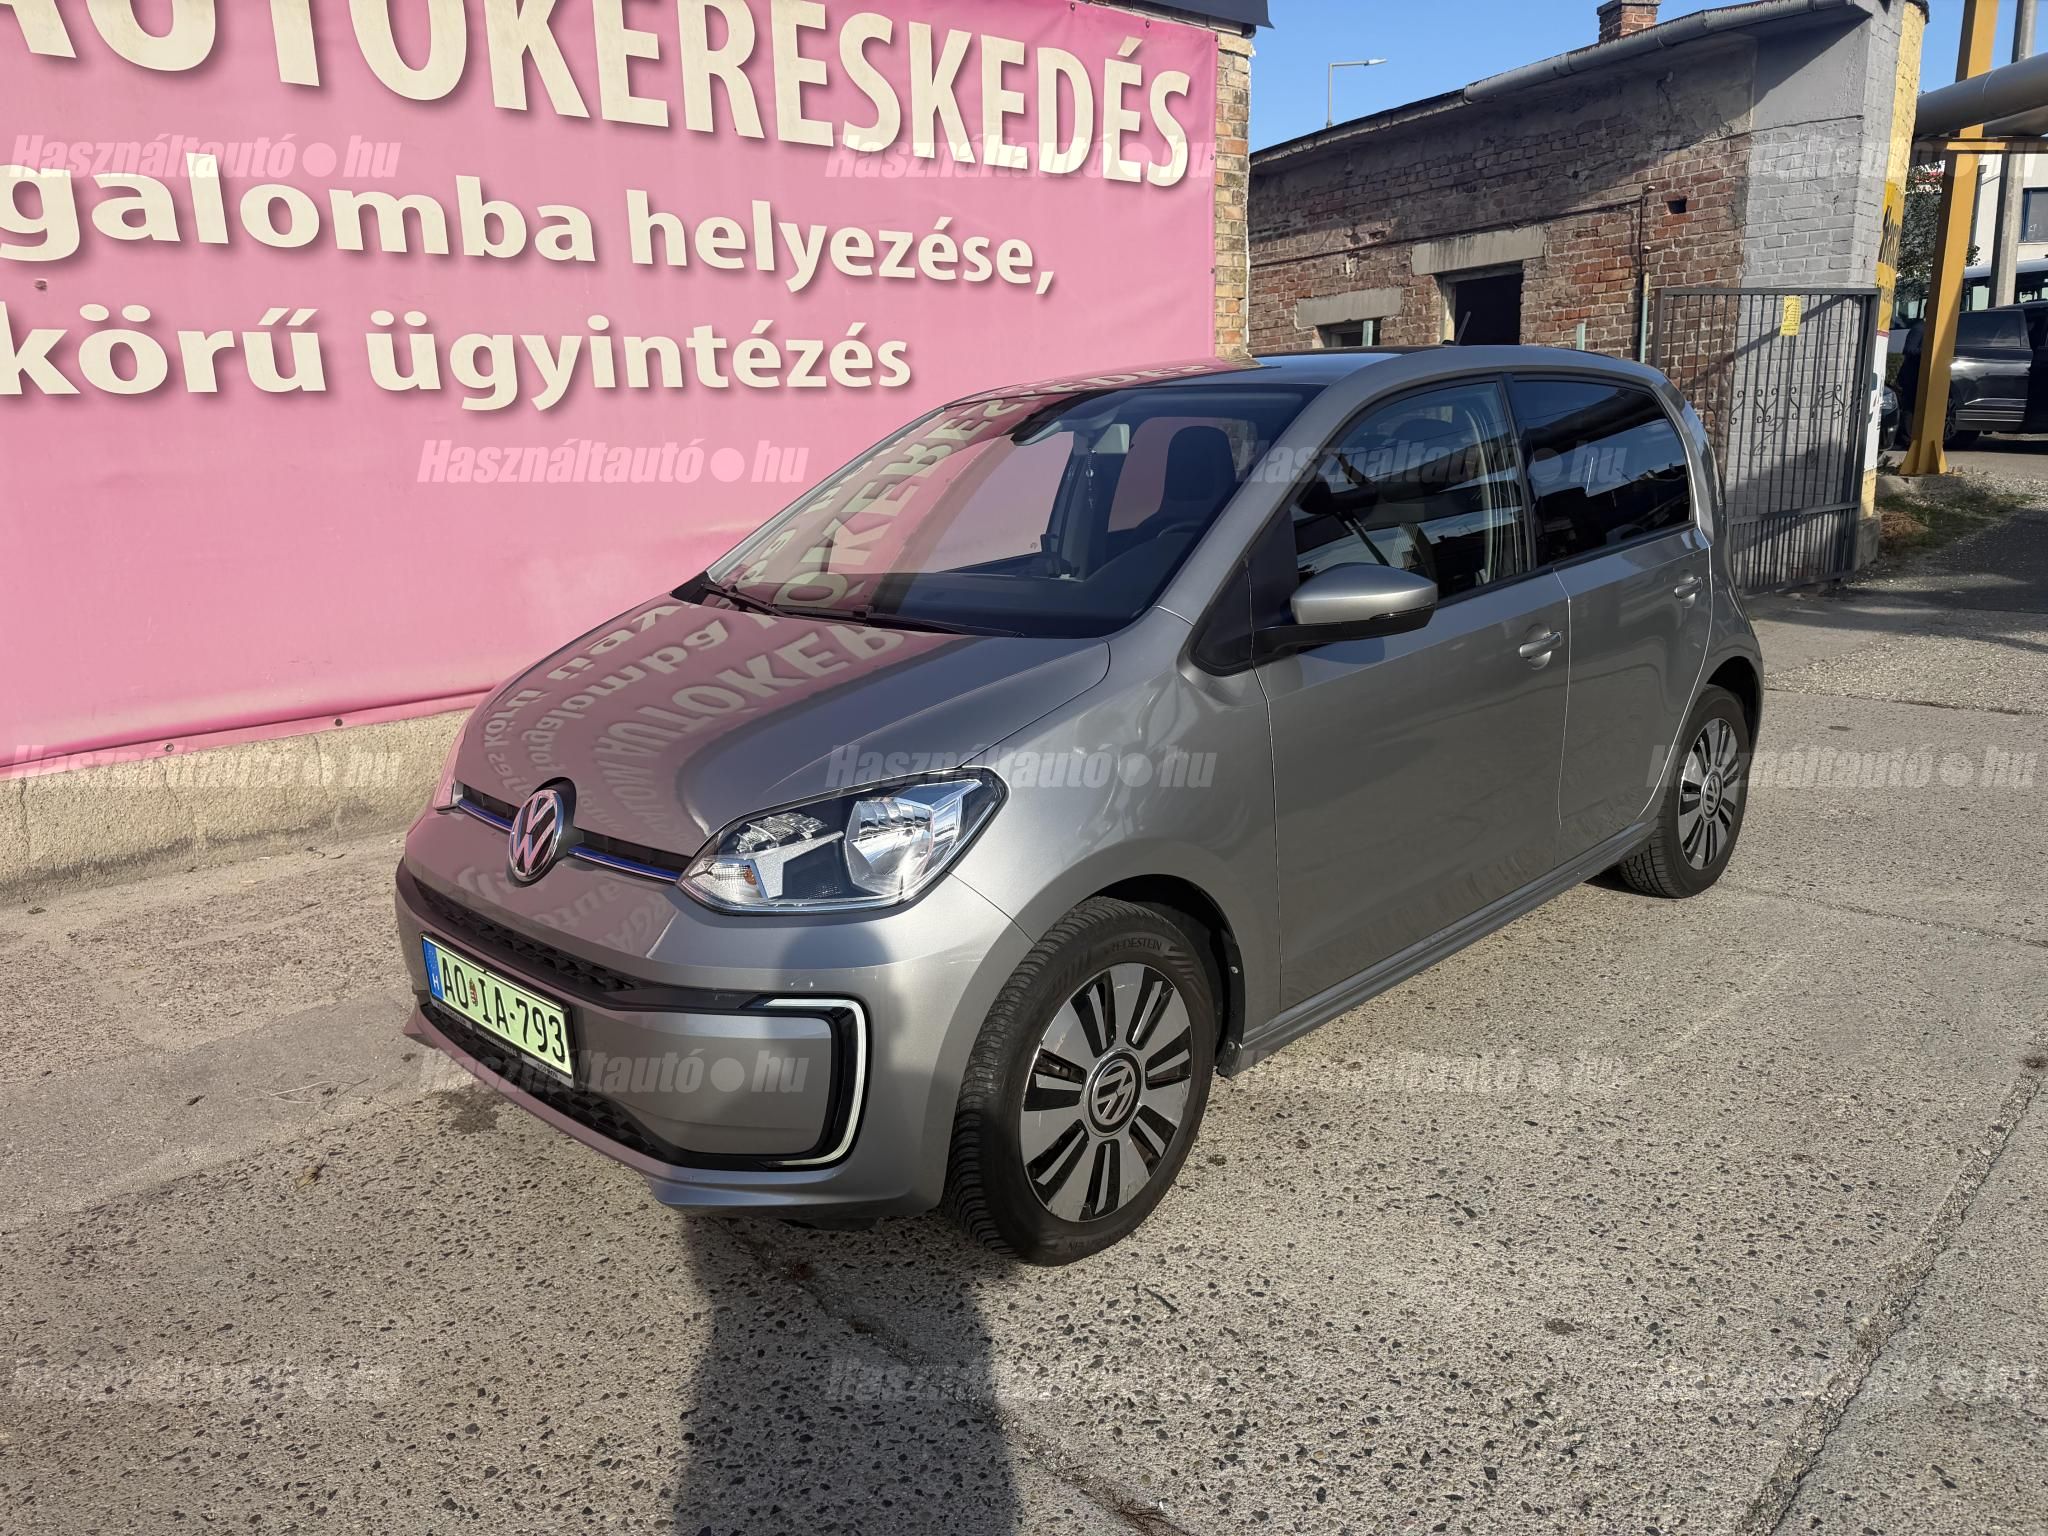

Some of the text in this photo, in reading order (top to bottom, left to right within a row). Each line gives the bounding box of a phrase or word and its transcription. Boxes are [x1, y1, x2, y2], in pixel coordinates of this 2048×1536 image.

[0, 0, 1190, 187] KERESKEDÉS
[626, 189, 1055, 294] helyezése,
[0, 303, 912, 411] körű ügyintézés
